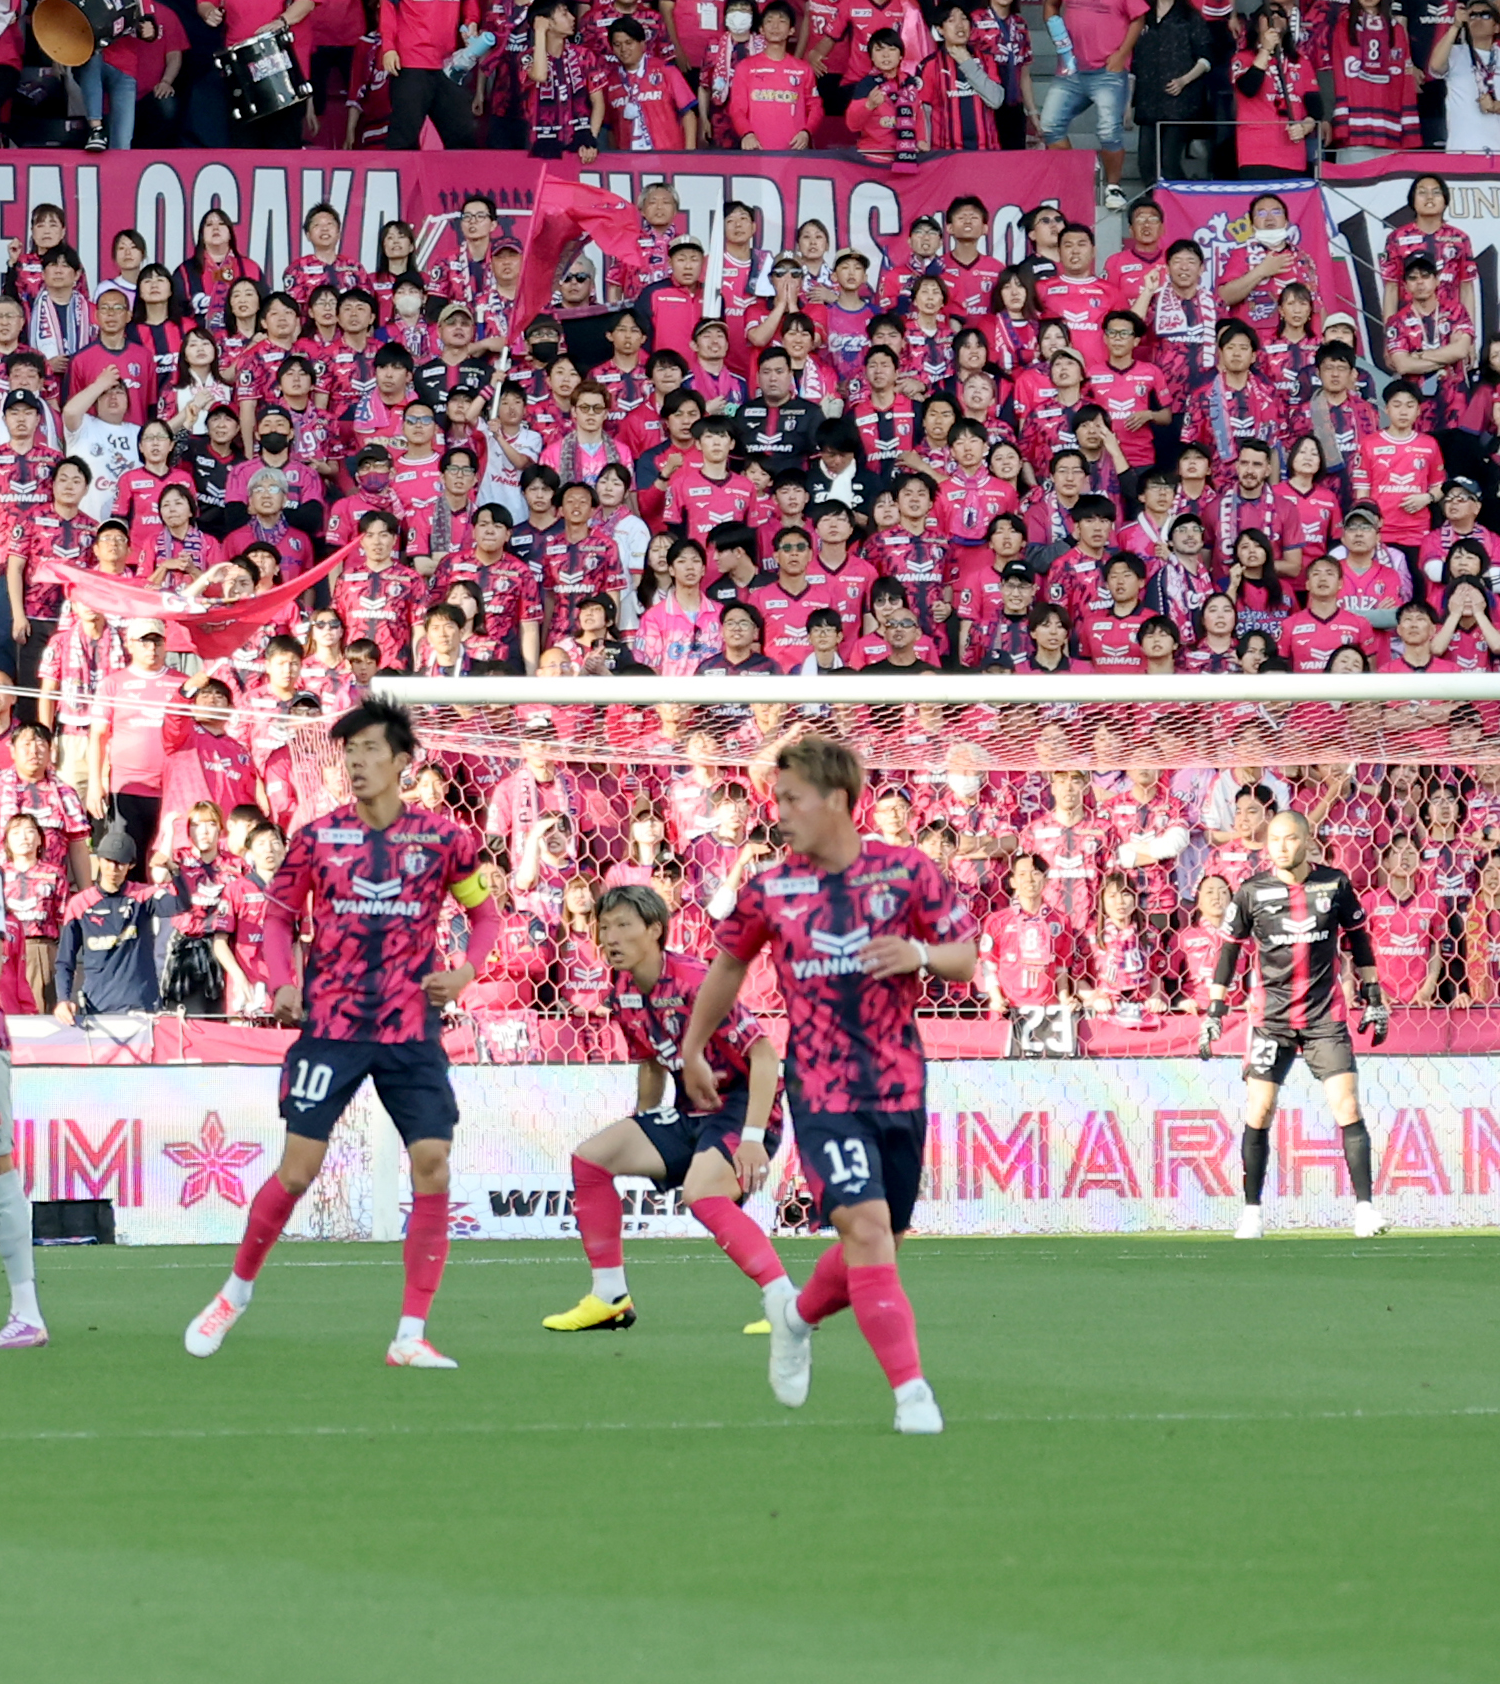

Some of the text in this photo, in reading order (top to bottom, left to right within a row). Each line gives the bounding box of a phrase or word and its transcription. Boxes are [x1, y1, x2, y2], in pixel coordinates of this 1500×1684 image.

[1368, 39, 1379, 60] 8
[331, 899, 422, 916] YANMAR
[1268, 931, 1328, 946] YANMAR
[791, 957, 875, 977] YANM
[1019, 1004, 1076, 1058] 23
[1249, 1036, 1280, 1067] 23
[290, 1057, 336, 1102] 10
[822, 1137, 871, 1185] 13
